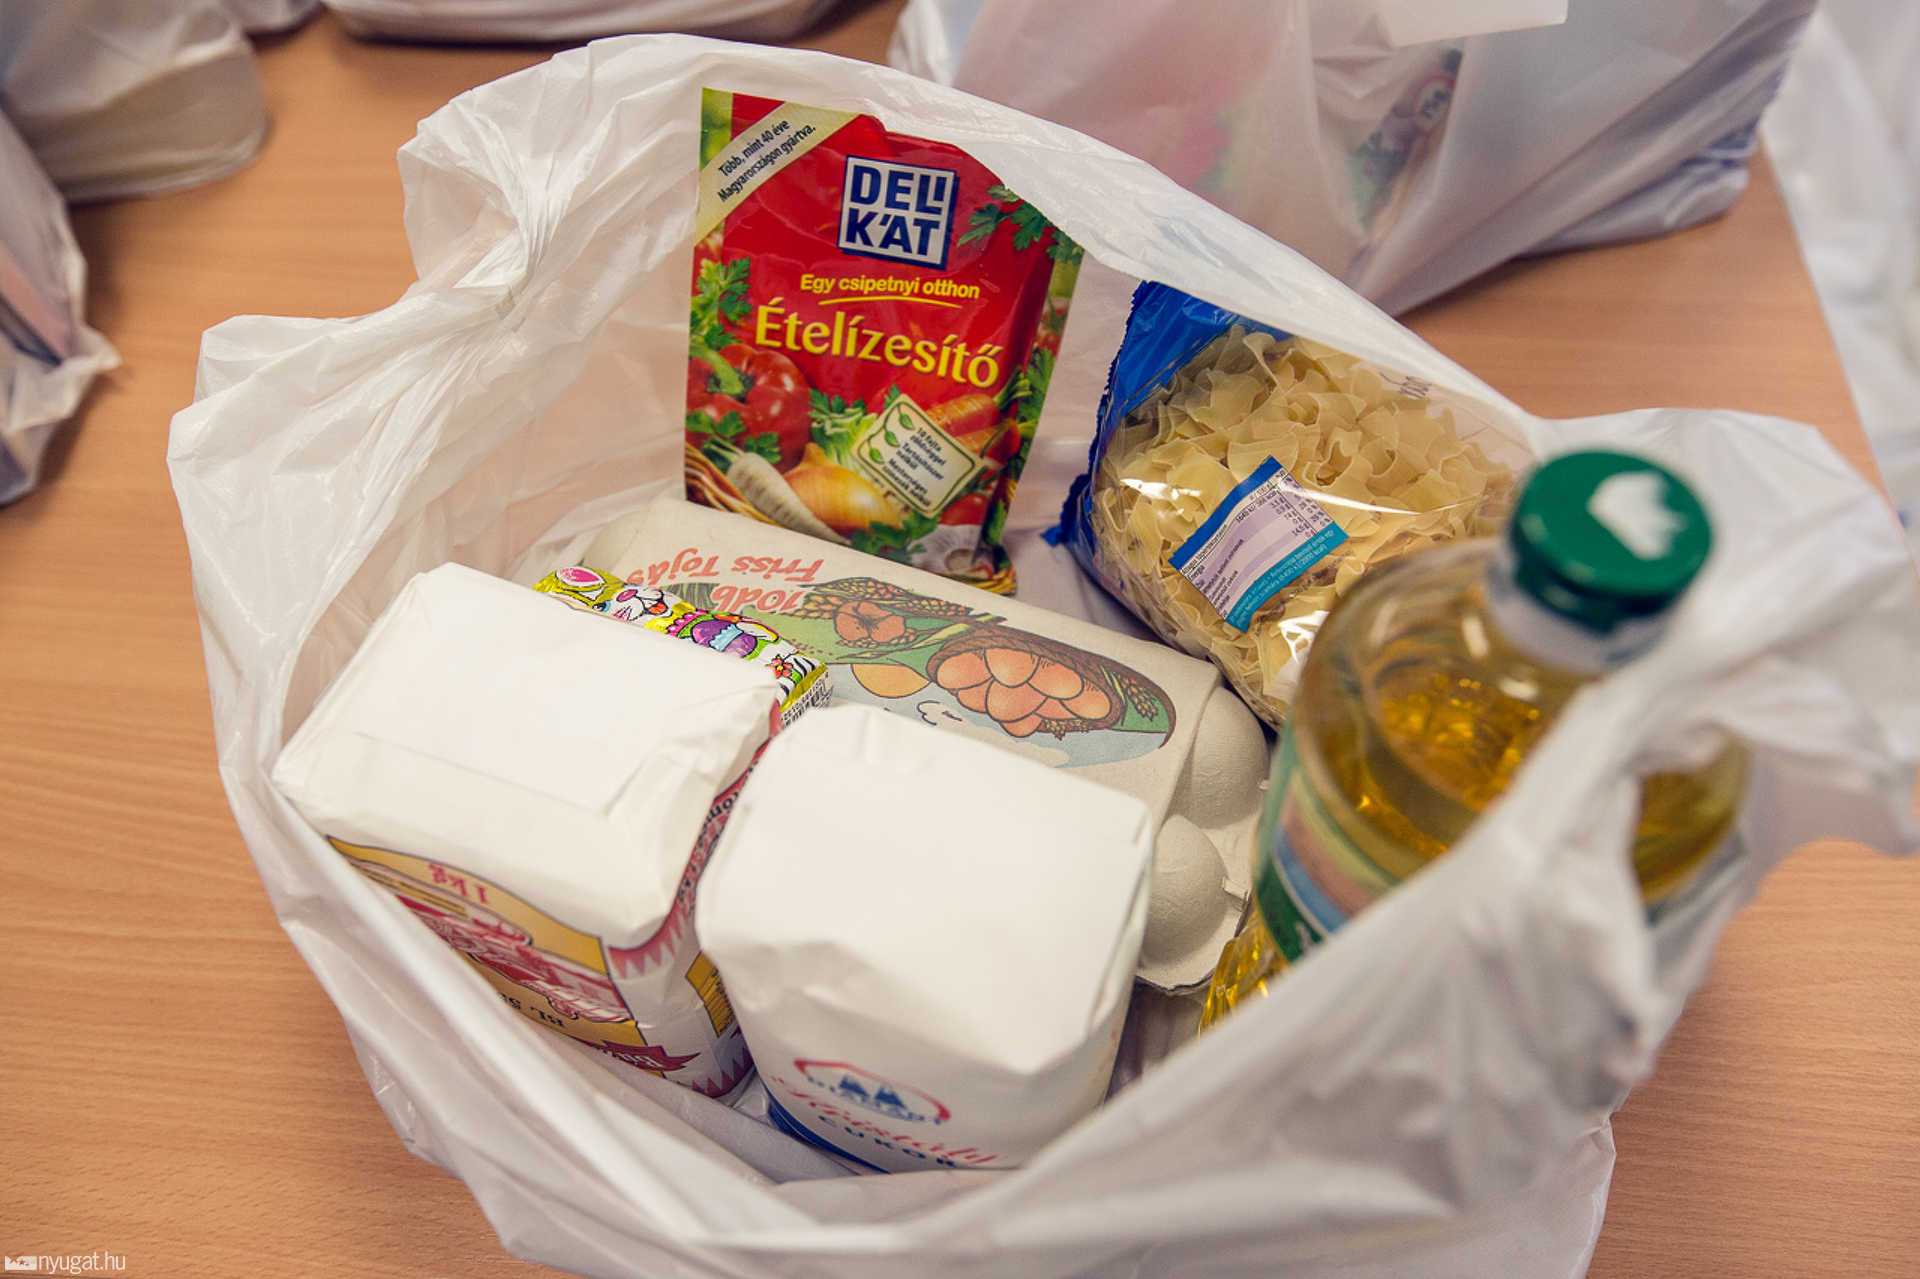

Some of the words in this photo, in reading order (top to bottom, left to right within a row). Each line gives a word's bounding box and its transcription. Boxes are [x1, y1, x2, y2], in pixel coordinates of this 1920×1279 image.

[742, 138, 764, 159] mint
[760, 129, 774, 143] 40
[771, 119, 790, 137] éve
[717, 146, 783, 203] Magyarországon
[780, 124, 816, 155] gyártva.
[801, 273, 836, 294] Egy
[838, 275, 921, 297] csipetnyi
[922, 280, 980, 300] otthon
[755, 296, 1004, 389] Ételízesítő
[730, 556, 825, 583] Friss
[428, 862, 468, 898] kg
